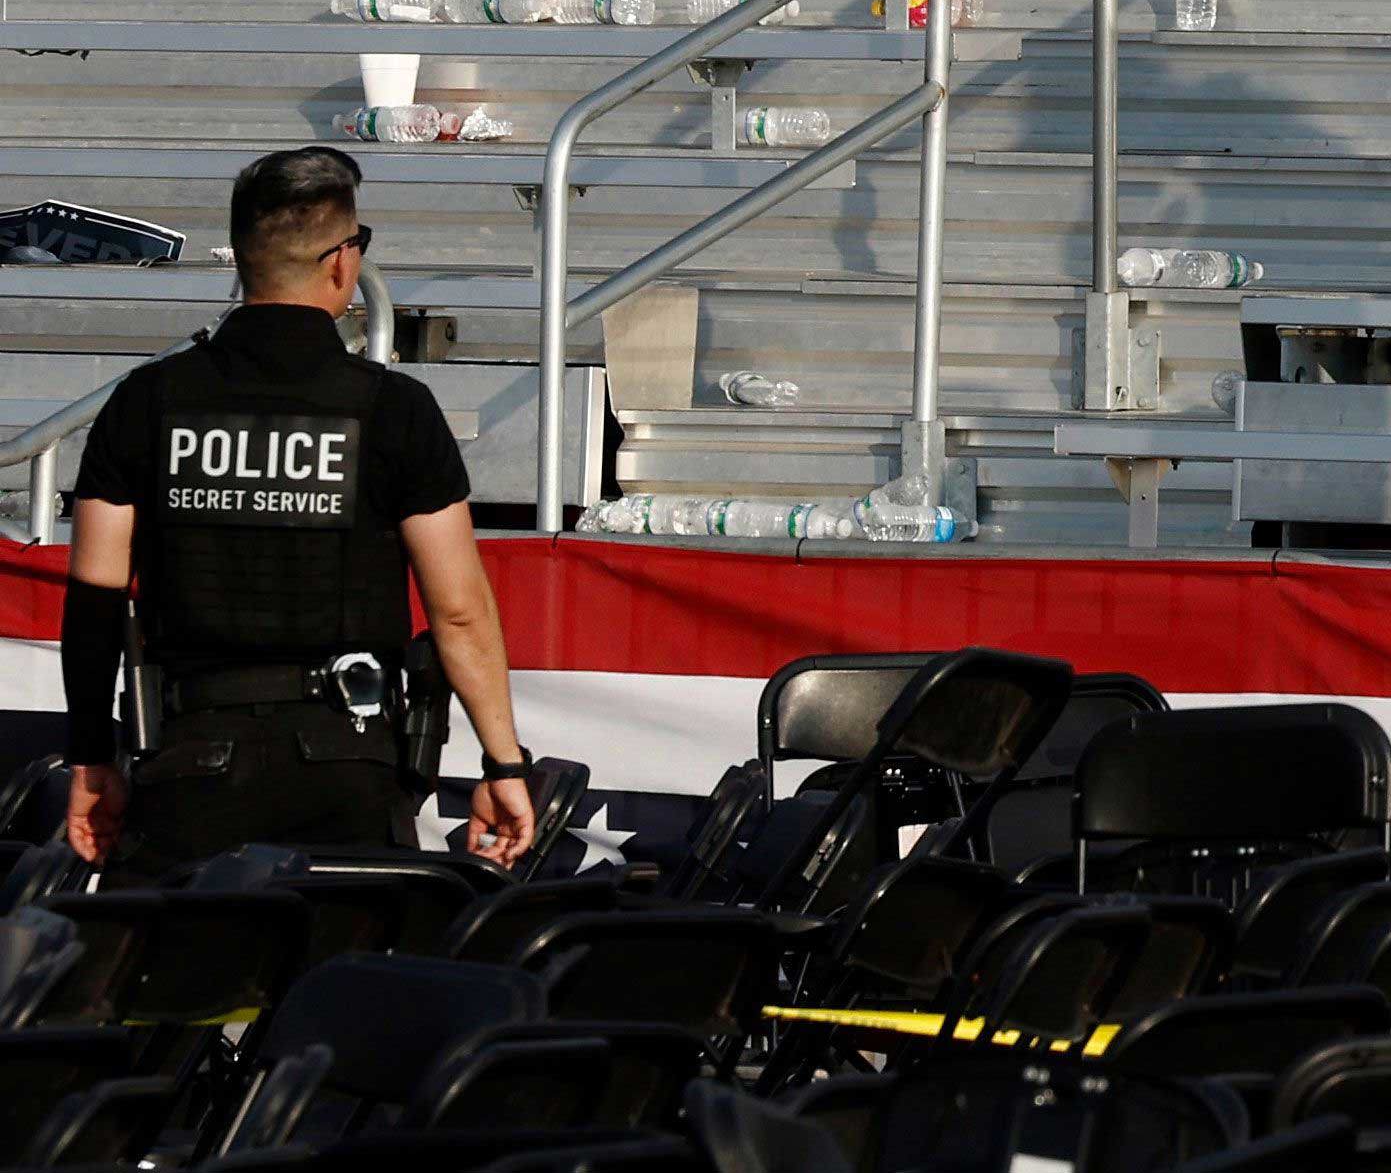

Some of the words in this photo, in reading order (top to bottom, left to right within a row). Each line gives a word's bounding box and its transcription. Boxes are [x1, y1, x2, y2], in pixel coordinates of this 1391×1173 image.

[169, 427, 347, 482] POLICE
[168, 487, 247, 511] SECRET
[252, 490, 343, 514] SERVICE
